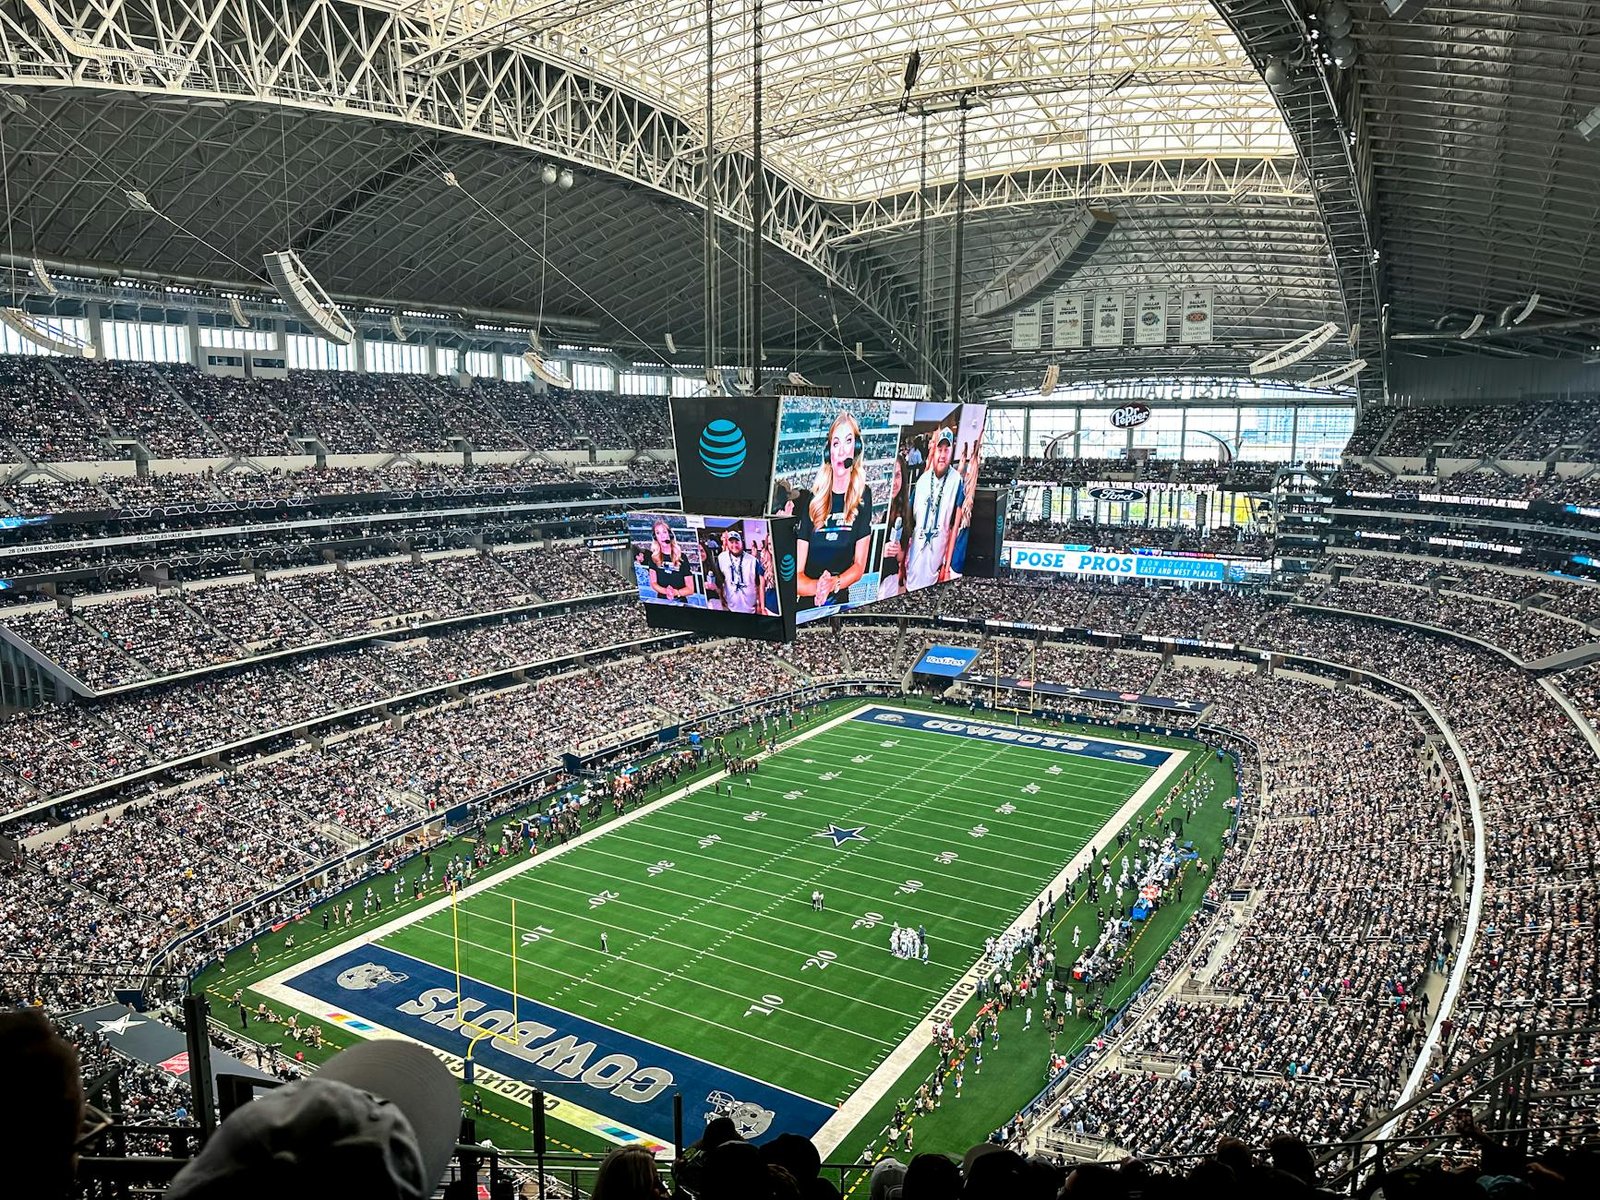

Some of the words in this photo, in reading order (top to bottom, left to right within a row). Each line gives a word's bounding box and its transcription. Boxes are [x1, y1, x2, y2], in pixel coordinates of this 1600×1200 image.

[873, 381, 895, 398] AT&T
[895, 382, 928, 400] STADIUM
[1115, 409, 1149, 426] Pepper
[1125, 406, 1140, 416] Dr
[1087, 481, 1110, 489] MAKE
[1110, 481, 1132, 489] YOUR
[1134, 482, 1166, 491] CRYPTO
[1168, 483, 1188, 491] PLAY
[1191, 484, 1219, 492] TODAY
[1100, 489, 1134, 501] Ford
[1419, 493, 1440, 502] MAKE
[1440, 494, 1460, 504] YOUR
[1460, 496, 1489, 506] CRYPTO
[1489, 498, 1506, 508] PLAY
[1507, 500, 1530, 510] TODAY
[1447, 538, 1463, 548] YOUR
[1464, 540, 1488, 550] CRYPTO
[1488, 543, 1503, 552] PLAY
[1015, 551, 1066, 568] POSE
[1078, 555, 1134, 573] PROS
[1163, 561, 1201, 569] LOCATED
[1140, 566, 1159, 574] EAST
[1161, 567, 1172, 575] AND
[1173, 568, 1190, 577] WEST
[1192, 570, 1218, 578] PLAZAS
[1176, 638, 1199, 646] CRYPTO
[922, 719, 1089, 751] COWBOYS
[698, 834, 722, 846] 40
[938, 851, 959, 865] 50
[646, 860, 675, 874] 30
[899, 879, 924, 894] 40
[588, 890, 619, 906] 20
[854, 912, 884, 929] 30
[521, 925, 555, 943] 10
[806, 950, 837, 970] 20
[750, 994, 784, 1017] 10
[927, 982, 975, 1024] CANCER
[396, 988, 674, 1104] COWBOYS
[474, 1069, 560, 1111] CUCIAL
